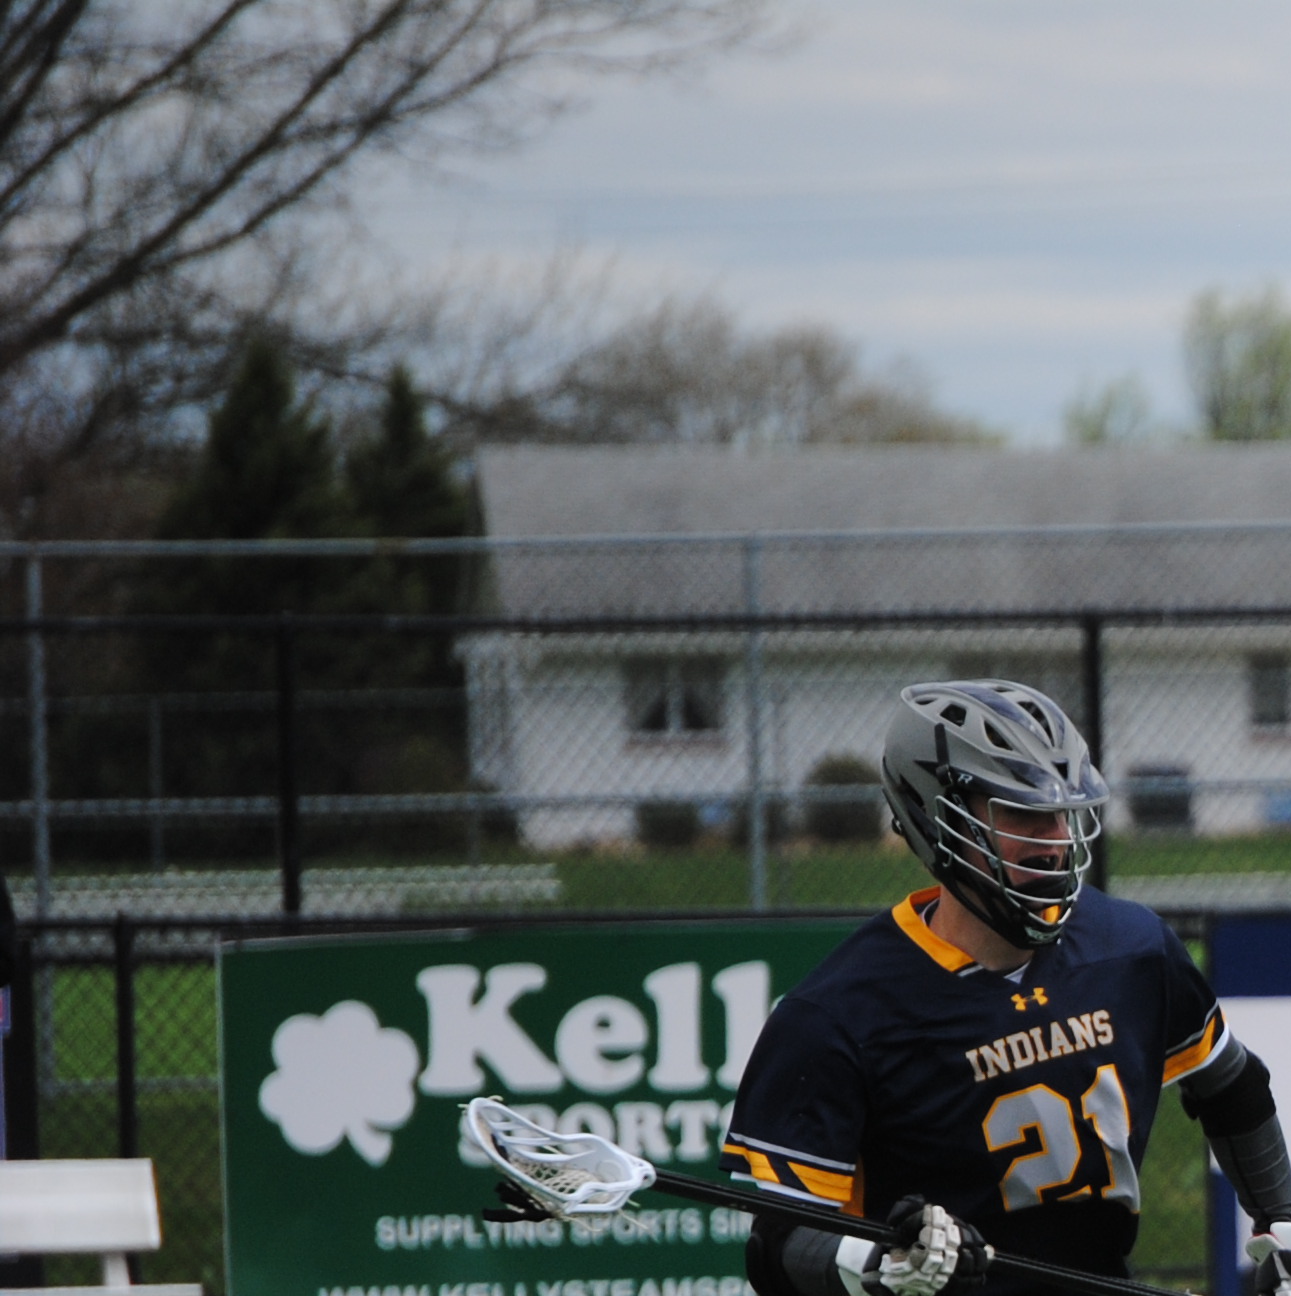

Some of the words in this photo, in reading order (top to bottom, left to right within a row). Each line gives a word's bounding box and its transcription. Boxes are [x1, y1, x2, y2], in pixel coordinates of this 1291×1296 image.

[415, 959, 787, 1097] Kell
[965, 1009, 1114, 1083] INDIANS
[981, 1063, 1141, 1213] 21
[375, 1211, 564, 1251] SUPPLYING
[570, 1207, 704, 1247] SPORTS
